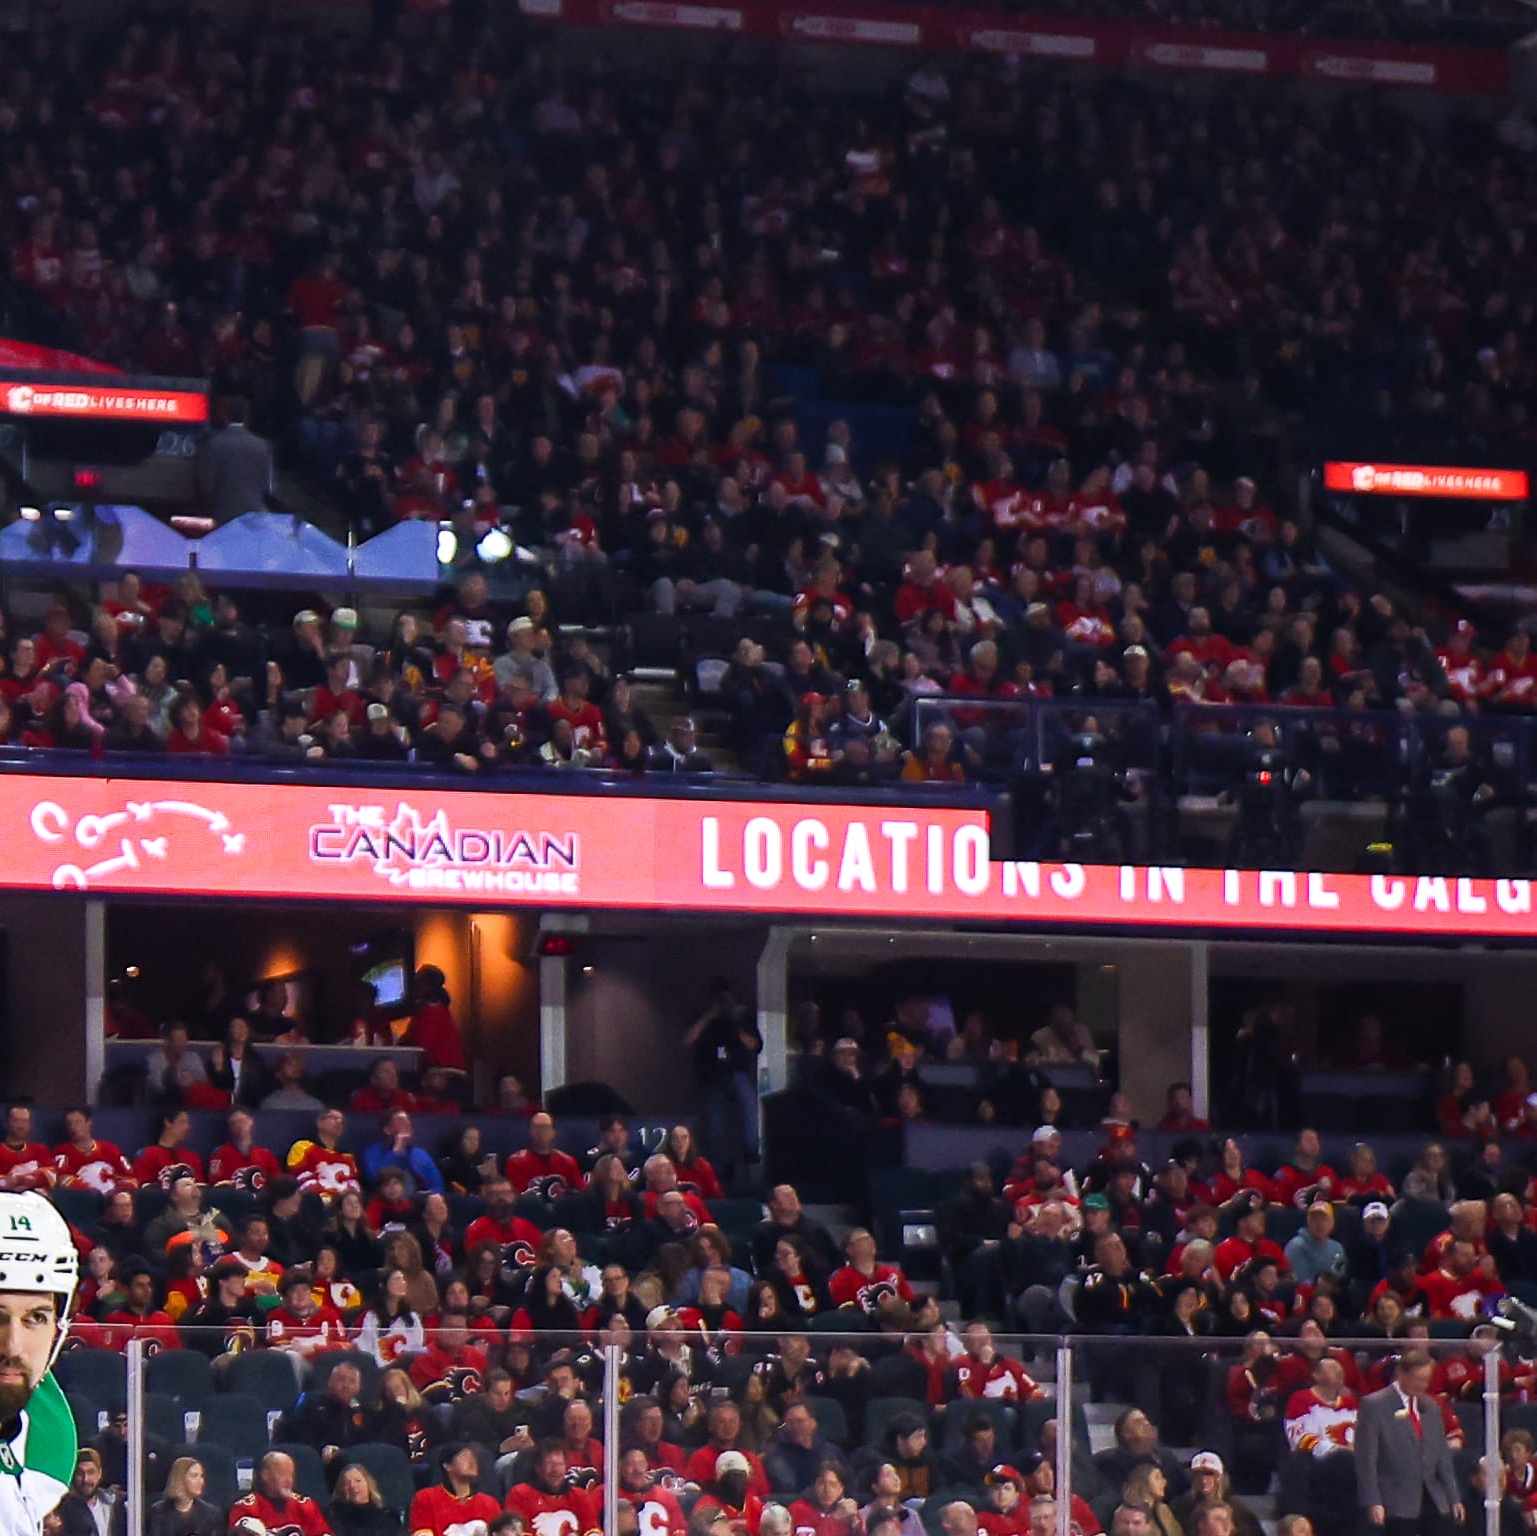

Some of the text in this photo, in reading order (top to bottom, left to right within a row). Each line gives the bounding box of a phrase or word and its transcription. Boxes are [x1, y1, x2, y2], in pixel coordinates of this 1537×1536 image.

[328, 804, 383, 826] THE
[310, 824, 579, 867] CANADIAN
[701, 816, 1086, 898] LOCATIONS
[409, 869, 579, 892] BREWHOUSE
[9, 1215, 32, 1230] 14
